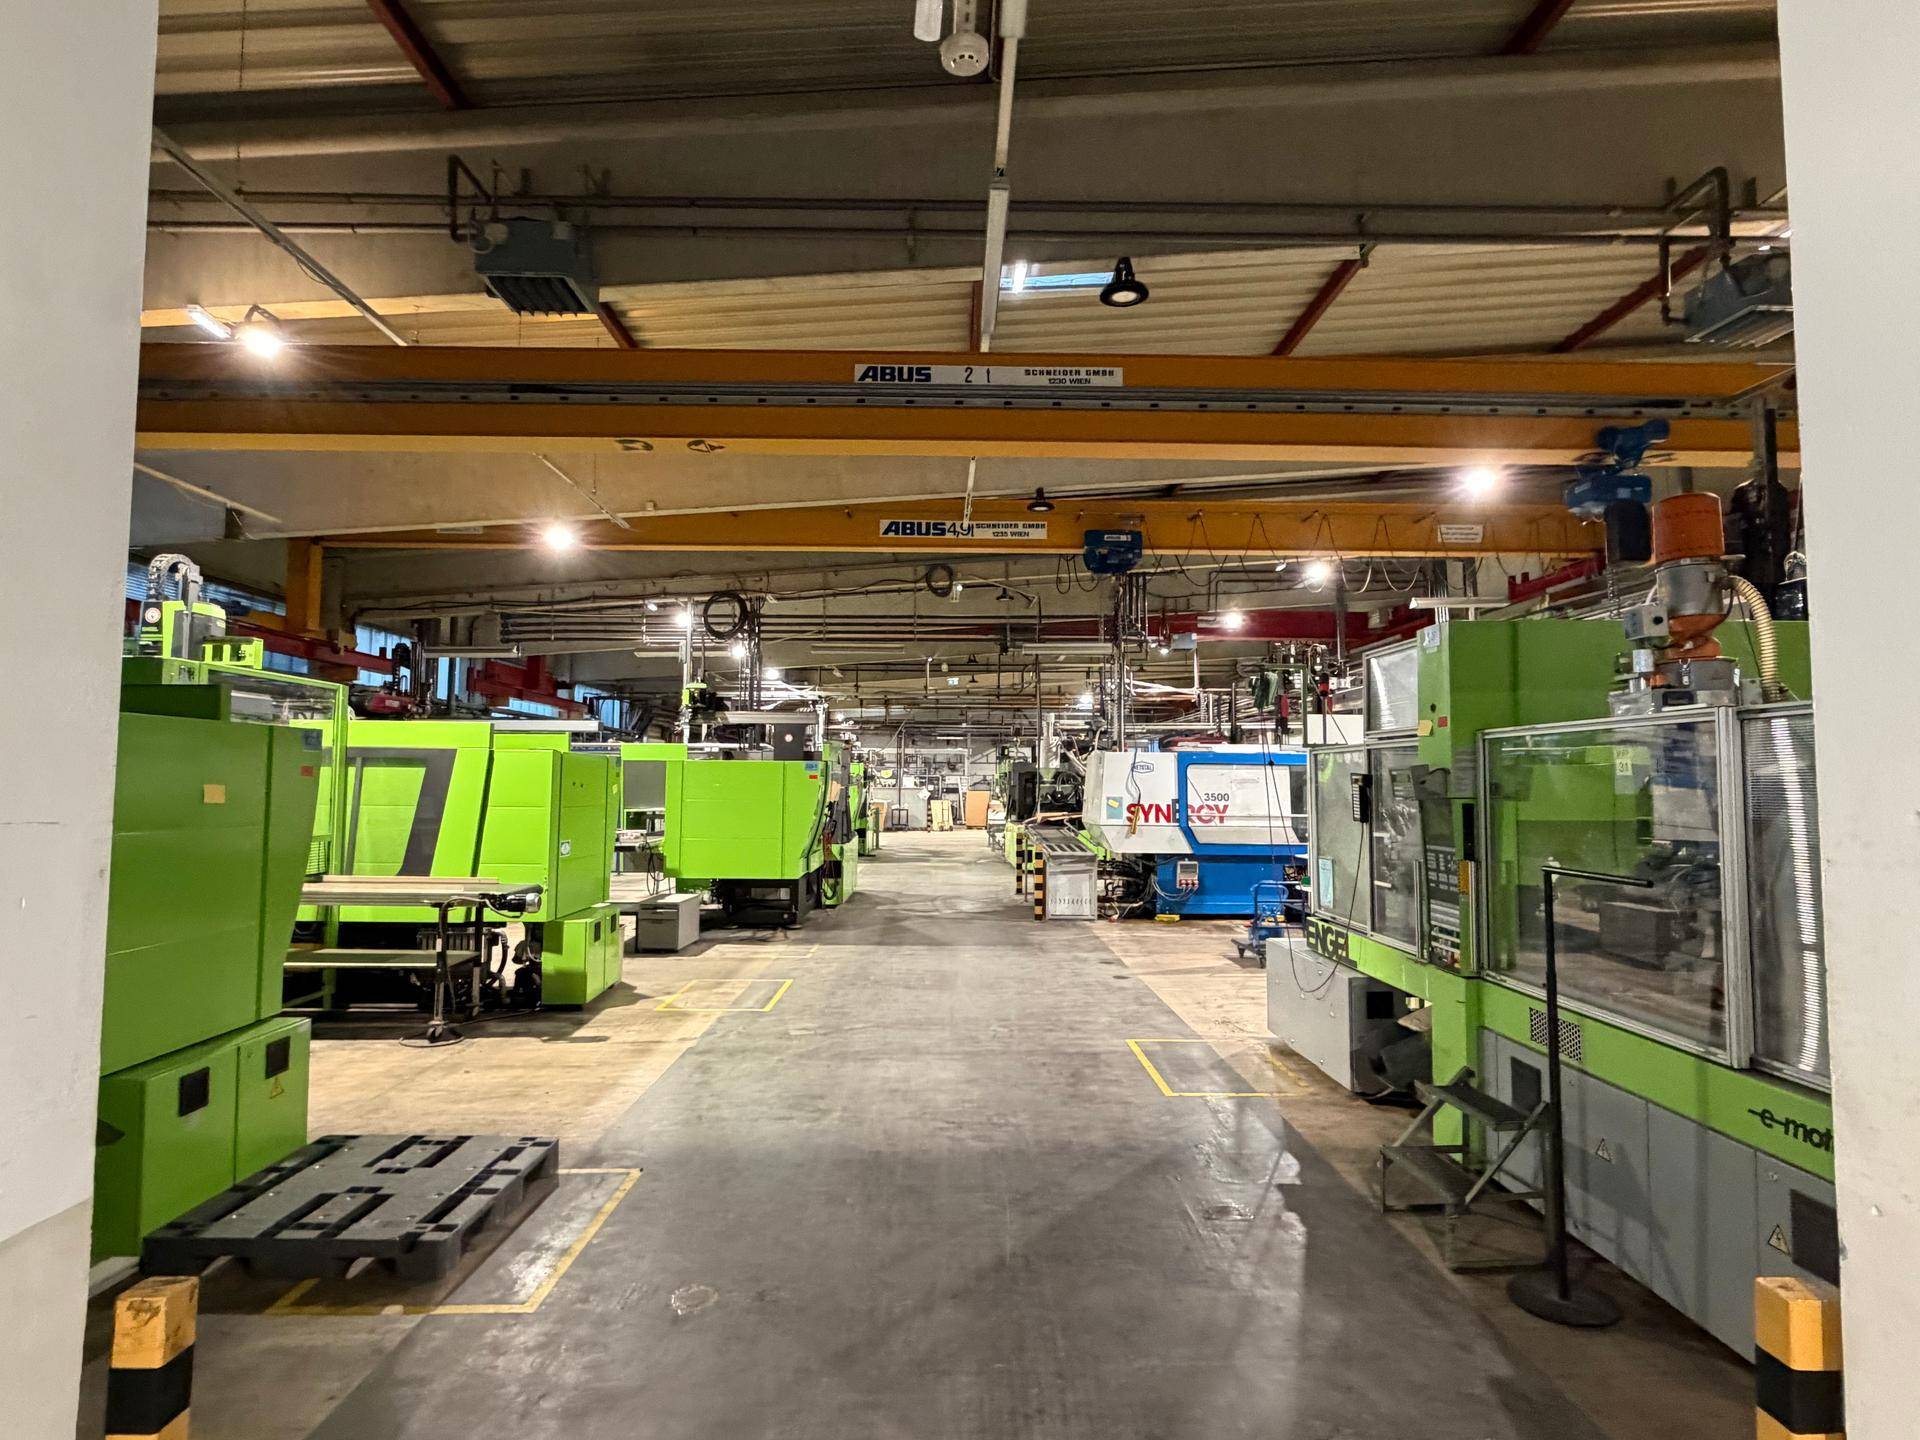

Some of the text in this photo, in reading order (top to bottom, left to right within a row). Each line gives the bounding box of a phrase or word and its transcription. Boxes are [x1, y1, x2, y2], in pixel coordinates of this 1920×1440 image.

[858, 365, 931, 382] ABUS
[965, 367, 973, 383] 2
[882, 521, 946, 536] ABUS
[1204, 793, 1230, 802] 3500
[1306, 918, 1358, 969] ENGEL
